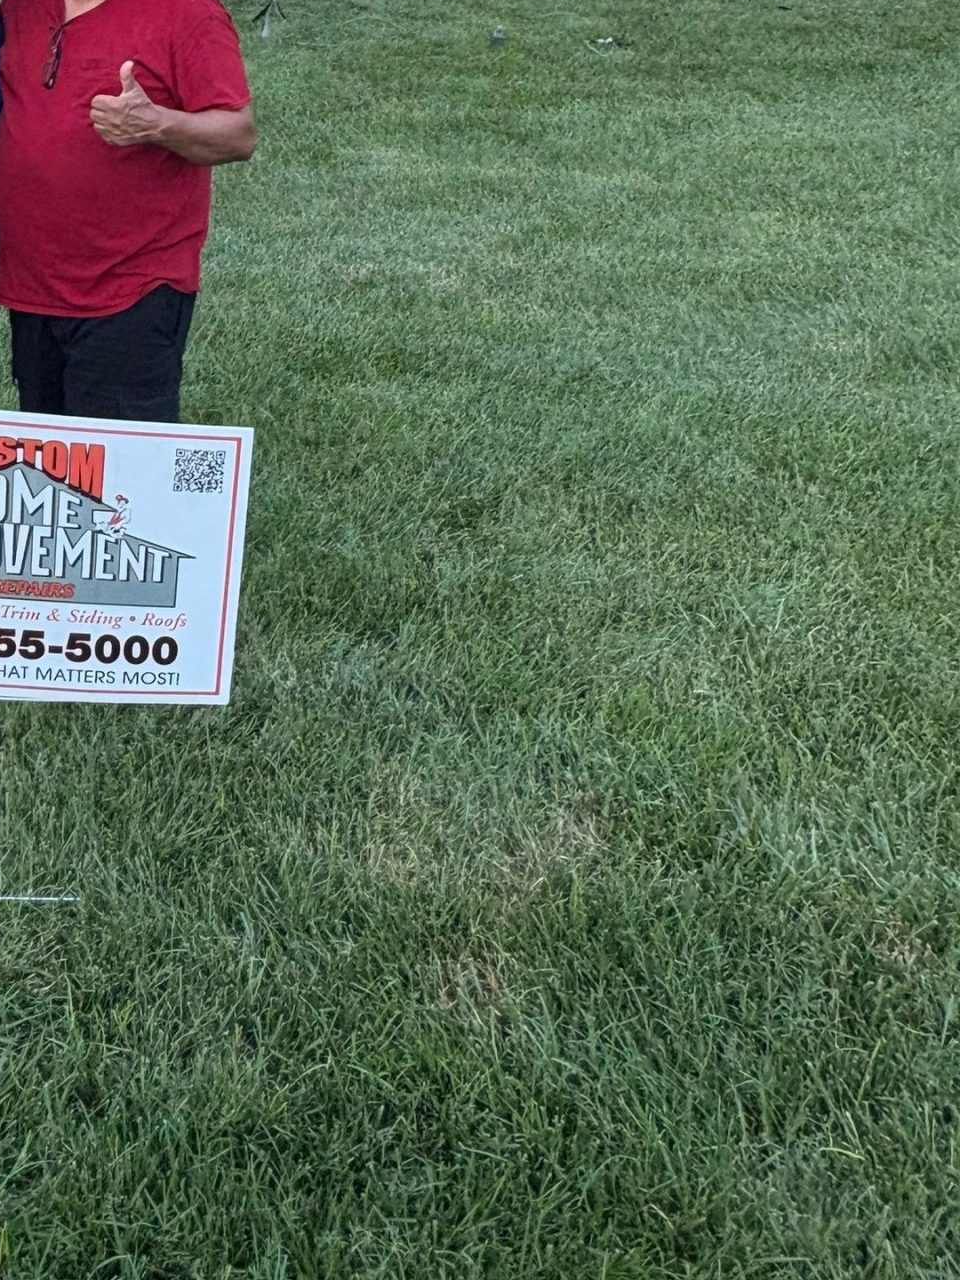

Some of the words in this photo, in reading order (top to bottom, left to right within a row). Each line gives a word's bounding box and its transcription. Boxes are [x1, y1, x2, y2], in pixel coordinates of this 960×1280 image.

[0, 605, 40, 620] Trim
[46, 608, 61, 622] &
[67, 609, 124, 630] Siding
[142, 612, 188, 630] Roofs
[35, 667, 117, 684] MATTERS
[122, 671, 180, 686] MOST!
